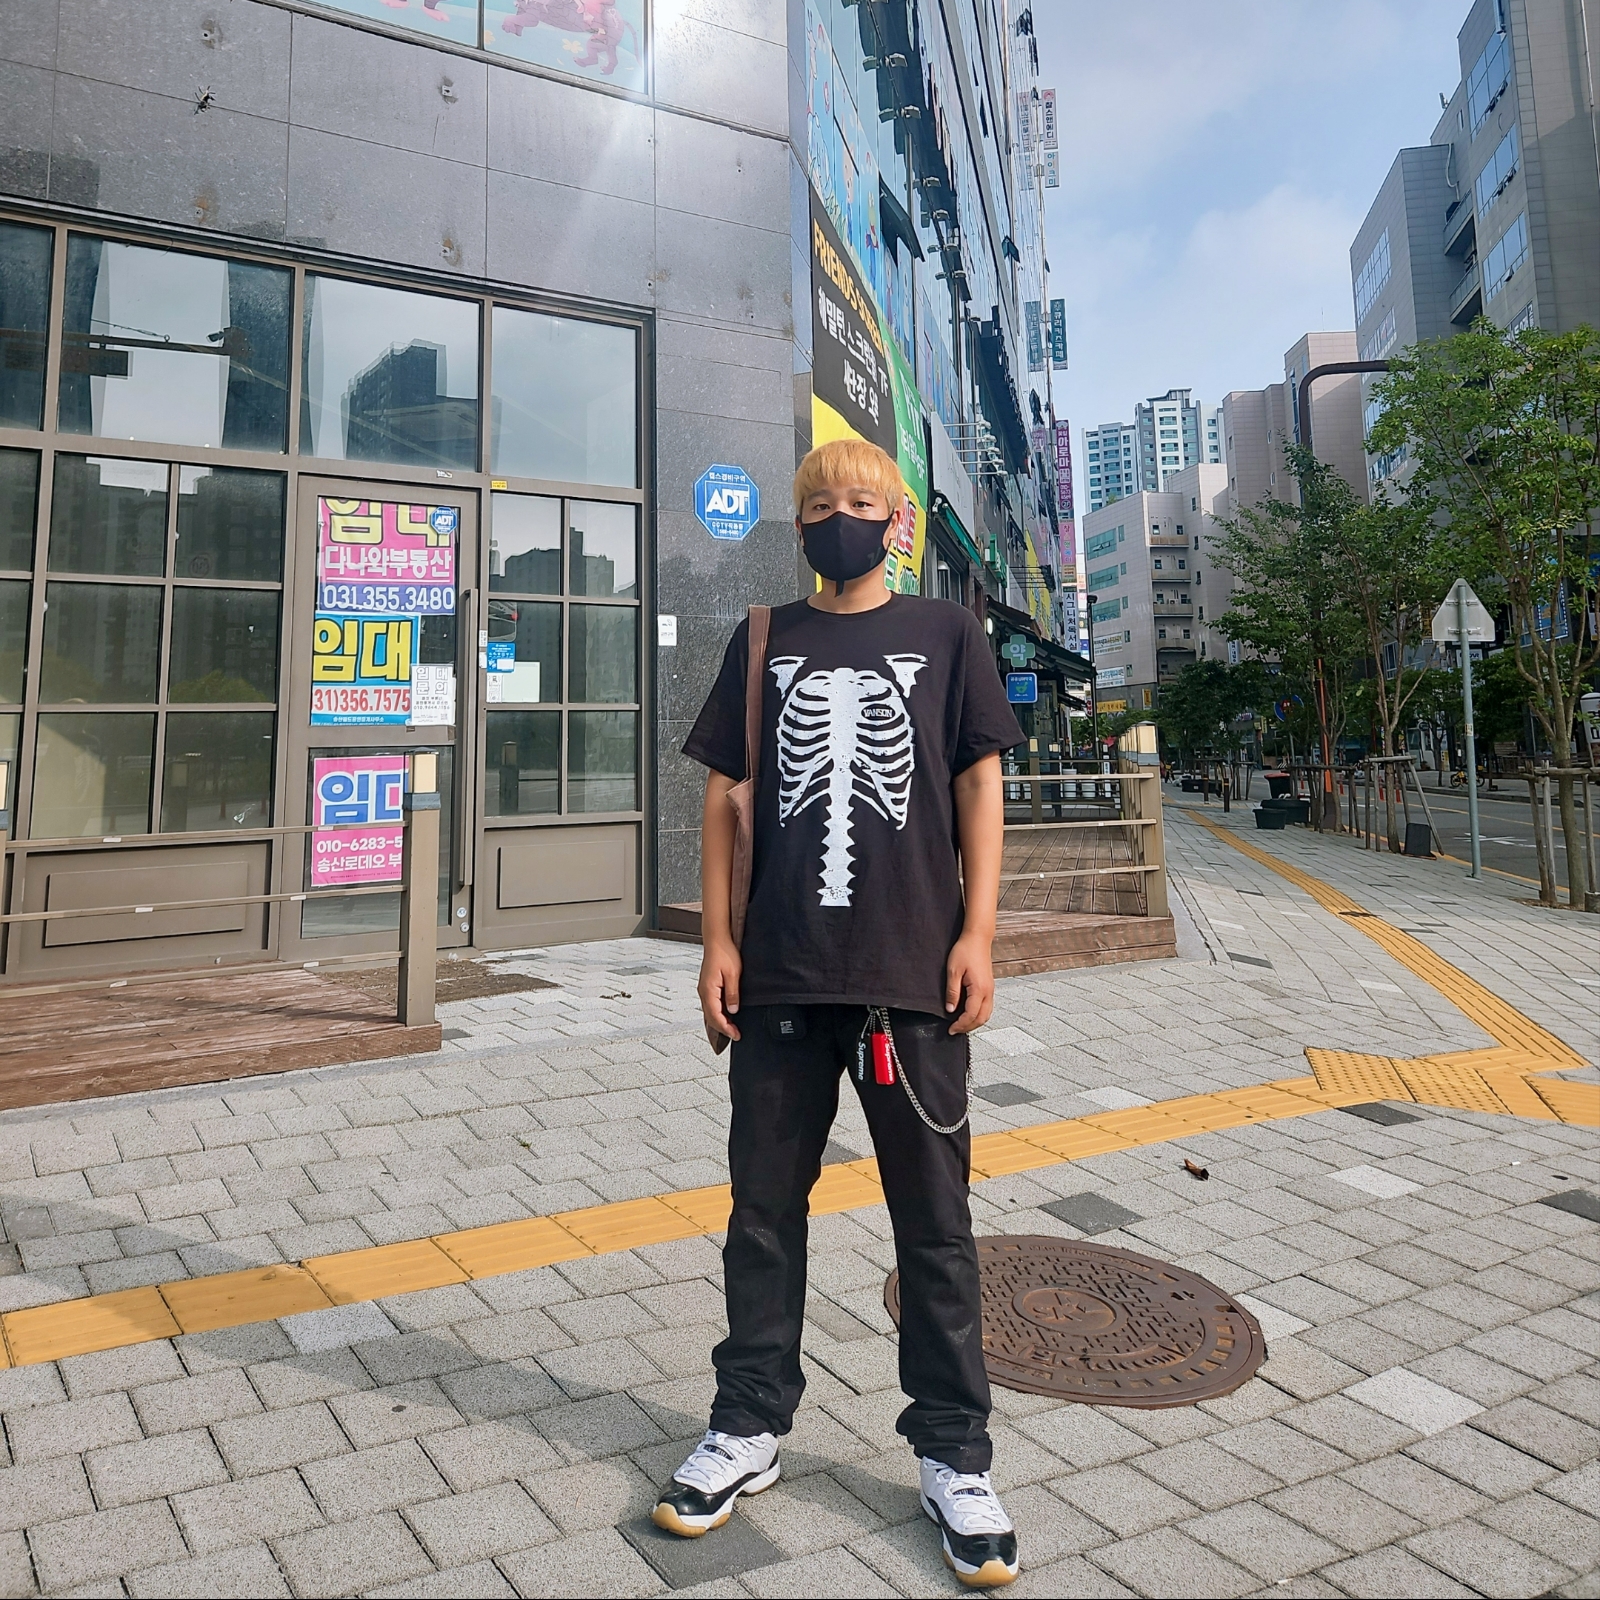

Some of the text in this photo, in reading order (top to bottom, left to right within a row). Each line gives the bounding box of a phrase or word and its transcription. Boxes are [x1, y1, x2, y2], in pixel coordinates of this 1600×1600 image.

[814, 217, 857, 311] FRIENDS
[1058, 437, 1070, 467] 아로마
[706, 488, 749, 516] ADT
[436, 515, 453, 526] ADT
[325, 545, 452, 579] 다나와부동산
[323, 585, 455, 611] 031.355.3480
[1066, 592, 1077, 651] 시그니처독서실
[312, 618, 413, 682] 임대
[1009, 643, 1027, 661] 약
[317, 854, 386, 874] 송산로데오
[857, 1041, 867, 1081] Supreme
[884, 1042, 895, 1082] Supreme
